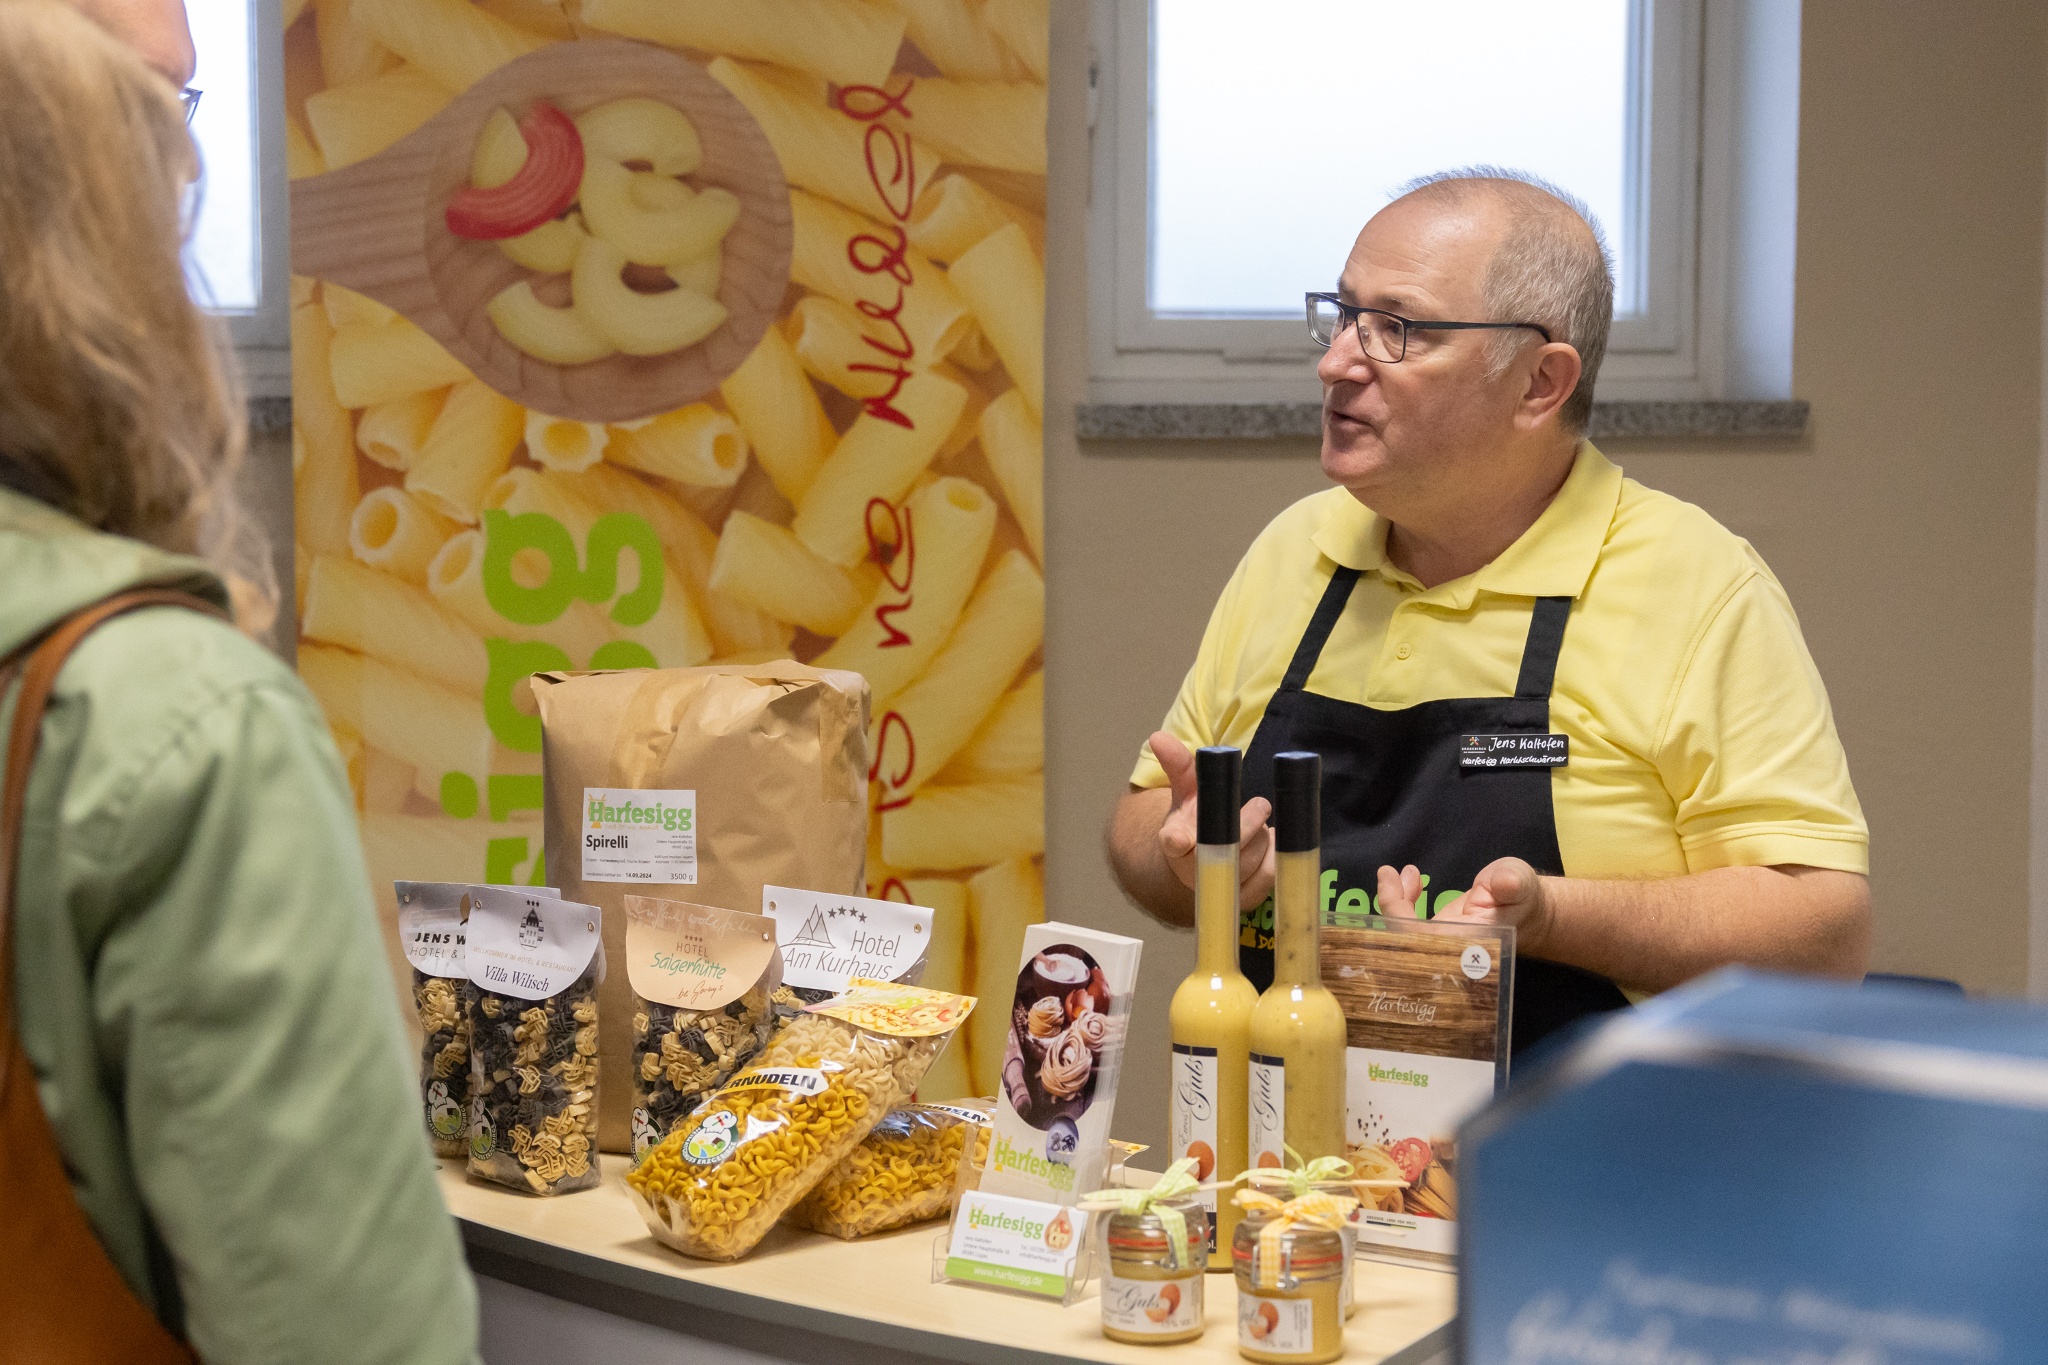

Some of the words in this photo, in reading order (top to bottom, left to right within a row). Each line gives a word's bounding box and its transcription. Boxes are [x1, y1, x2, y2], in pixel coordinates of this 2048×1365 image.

[834, 78, 916, 431] Nudel
[865, 496, 916, 649] ne
[1488, 736, 1516, 752] Jens
[1520, 737, 1564, 751] Kaltofen
[589, 800, 692, 832] Harfesigg
[585, 834, 629, 851] Spirelli
[670, 873, 687, 881] 3500
[688, 874, 694, 882] g
[414, 932, 451, 944] JENS
[675, 942, 709, 958] HOTEL
[850, 929, 901, 958] Hotel
[409, 946, 446, 959] HOTEL
[472, 946, 509, 962] WILLKOMMEN
[509, 953, 517, 963] IM
[516, 955, 534, 966] HOTEL
[541, 960, 578, 973] RESTAURANT
[650, 952, 727, 980] Saigerhütte
[783, 947, 812, 969] Am
[815, 950, 893, 980] Kurhaus
[484, 964, 509, 984] Villa
[511, 970, 551, 993] Wilisch
[1367, 991, 1437, 1022] Harfesigg
[723, 1073, 818, 1091] ERNUDELN
[1369, 1065, 1429, 1087] Harfesigg
[994, 1138, 1077, 1193] Harfesigg
[968, 1208, 1044, 1240] Harfesigg
[973, 1265, 1044, 1286] www.harfesigg.de
